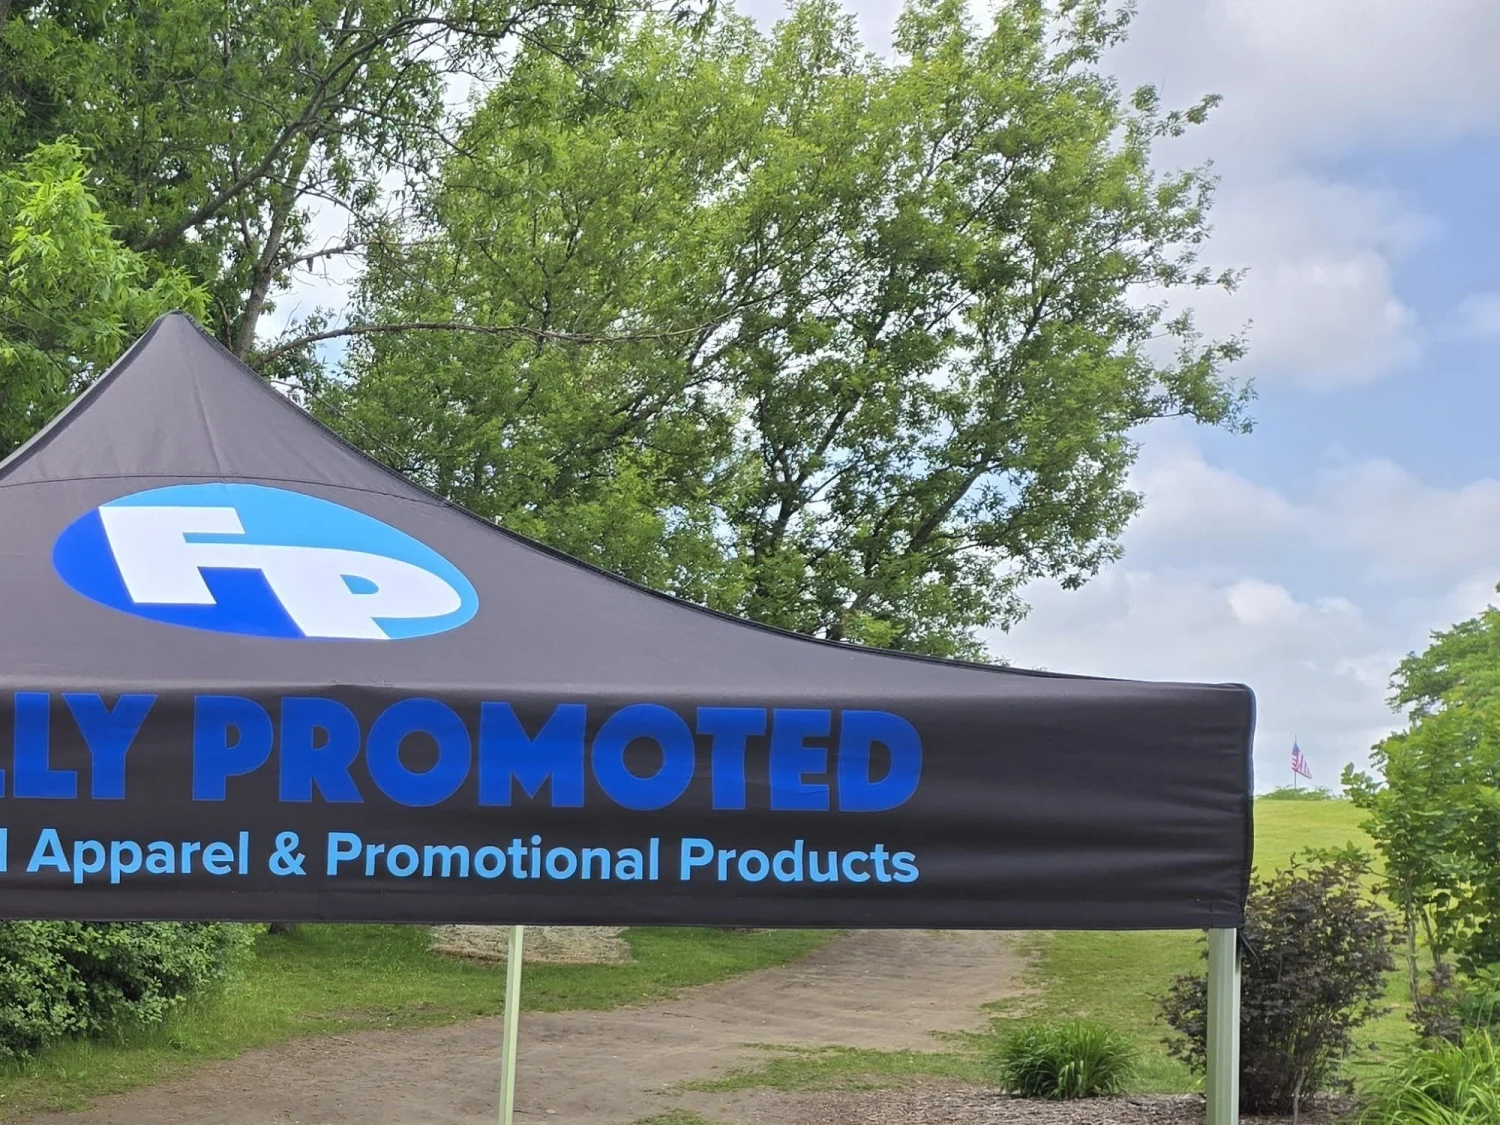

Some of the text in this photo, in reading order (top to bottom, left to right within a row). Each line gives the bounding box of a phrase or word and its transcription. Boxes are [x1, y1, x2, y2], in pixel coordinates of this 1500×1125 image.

[98, 505, 462, 640] FP
[192, 695, 922, 812] PROMOTED
[25, 828, 249, 884] Apparel
[268, 830, 307, 876] &
[326, 831, 660, 881] Promotional
[680, 837, 920, 884] Products
